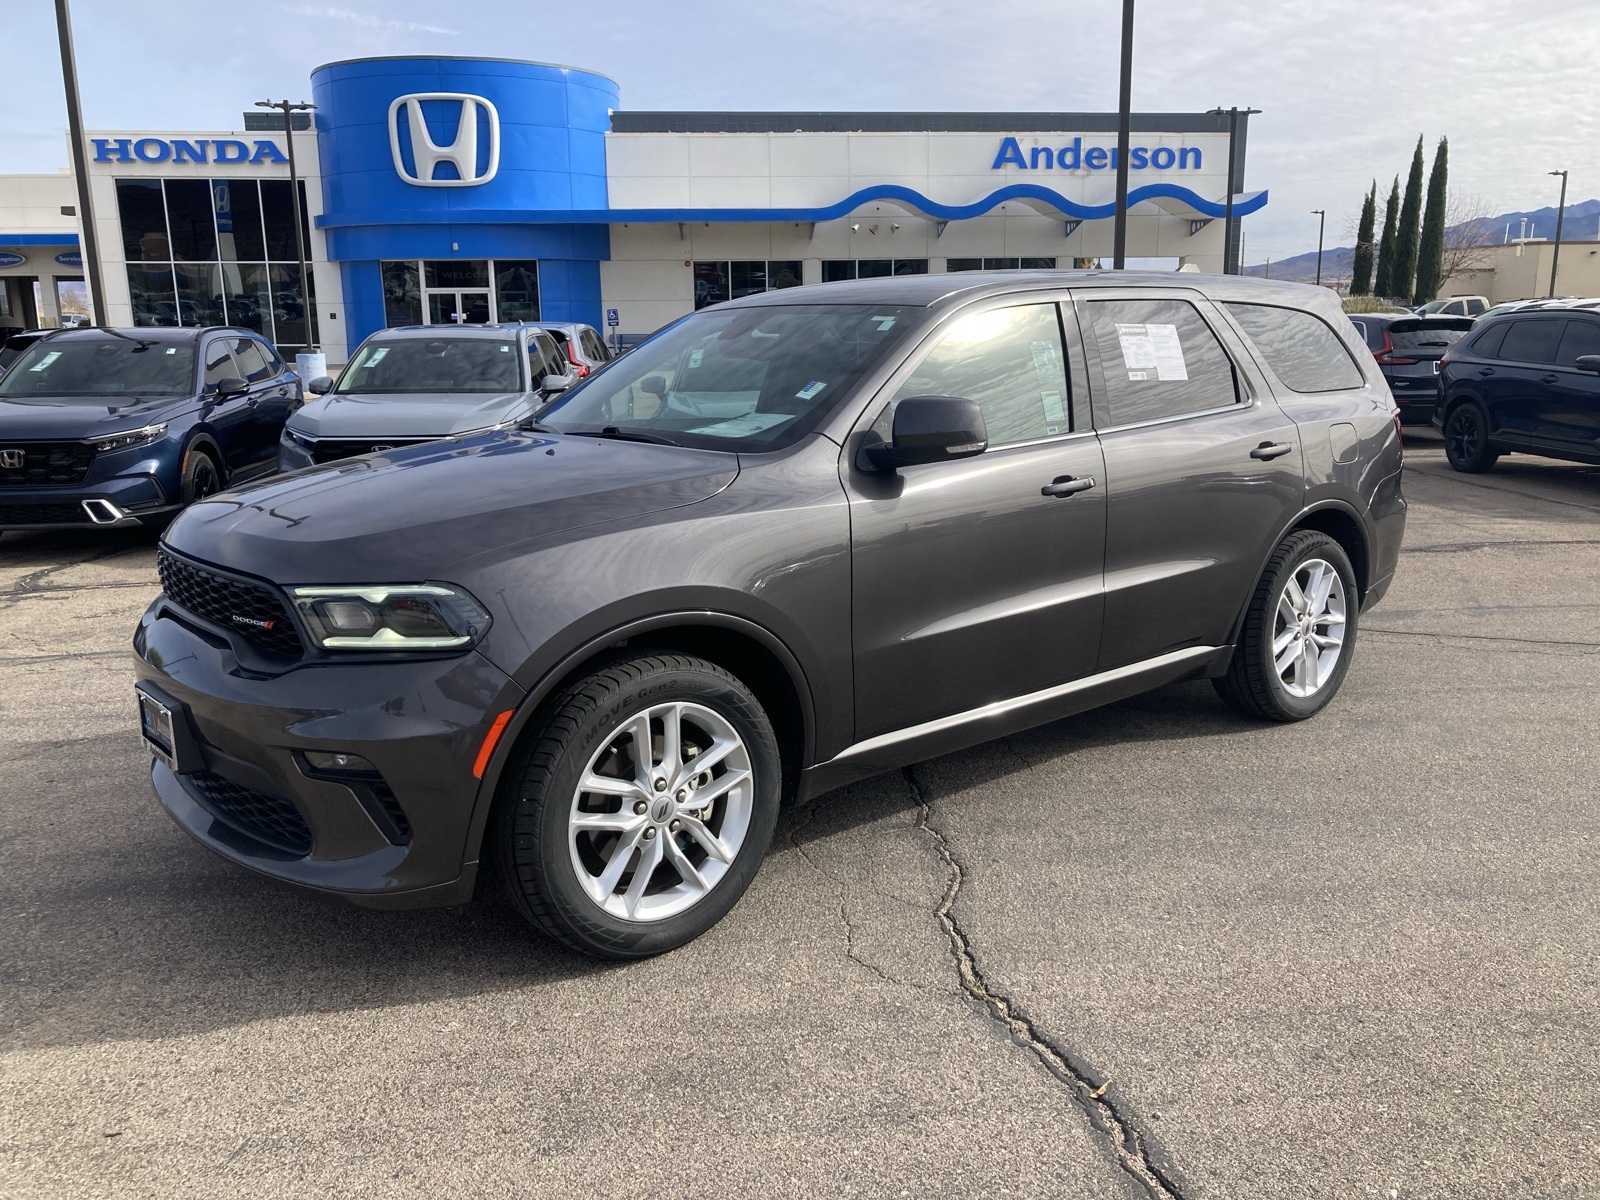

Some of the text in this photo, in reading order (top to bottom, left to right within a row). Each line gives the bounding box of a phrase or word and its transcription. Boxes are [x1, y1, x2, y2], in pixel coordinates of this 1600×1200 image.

[91, 138, 289, 164] HONDA
[991, 137, 1203, 170] Anderson
[442, 272, 488, 280] WELCO
[232, 614, 268, 628] DODGE
[637, 679, 678, 699] Gen2
